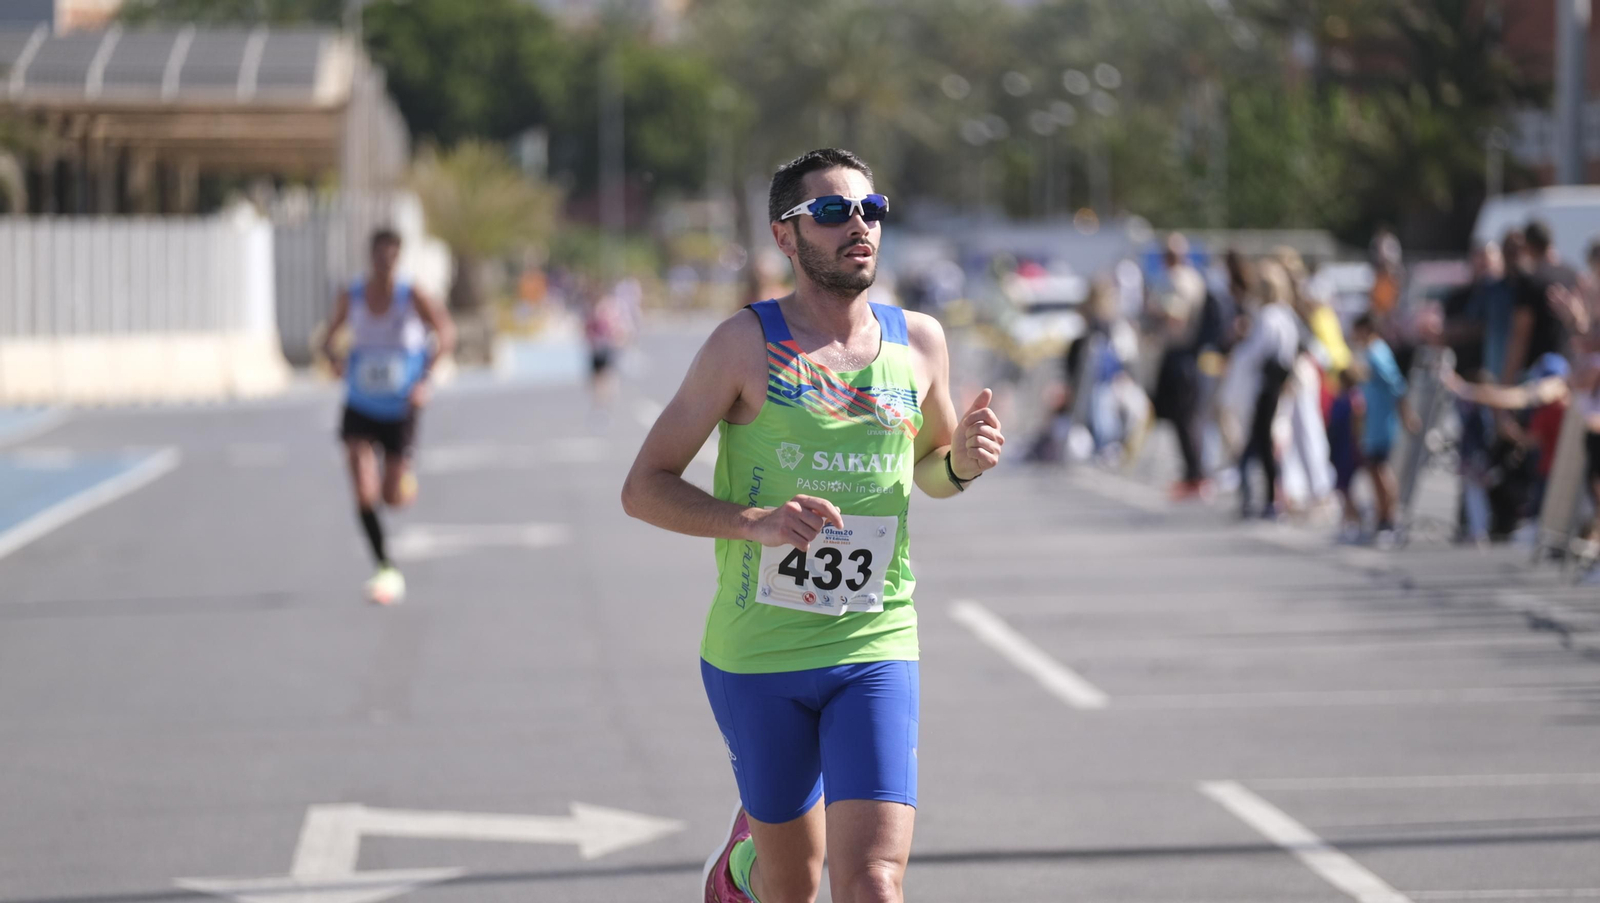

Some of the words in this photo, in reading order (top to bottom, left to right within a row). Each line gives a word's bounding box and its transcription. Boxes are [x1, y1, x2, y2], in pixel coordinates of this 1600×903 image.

[811, 450, 905, 473] SAKATA
[855, 483, 866, 493] in
[868, 482, 894, 494] Seed
[821, 528, 853, 536] 10km20
[735, 543, 753, 610] Running
[777, 546, 873, 592] 433
